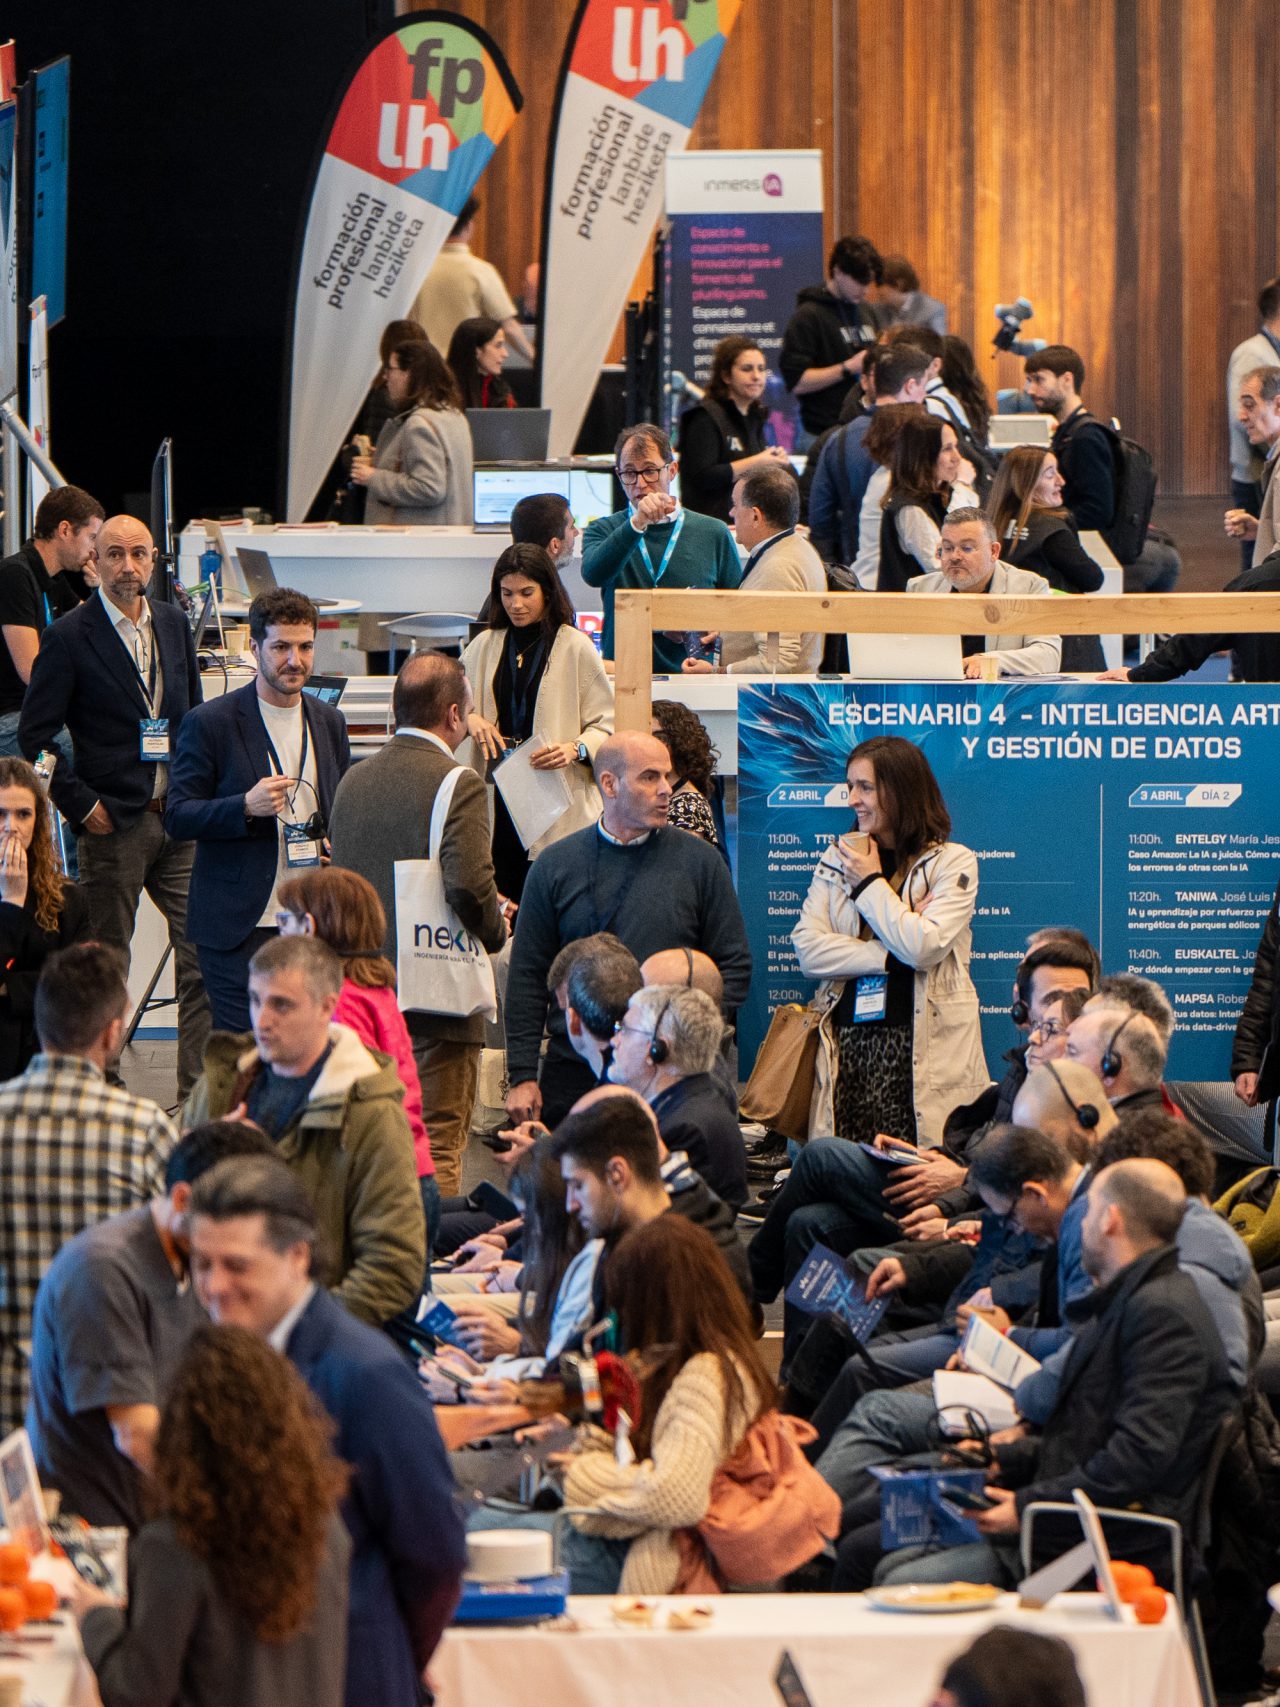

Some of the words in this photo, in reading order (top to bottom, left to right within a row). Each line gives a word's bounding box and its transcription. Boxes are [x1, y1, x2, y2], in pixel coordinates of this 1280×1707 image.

[612, 6, 686, 82] lh
[407, 38, 486, 118] fp
[377, 102, 450, 172] lh
[560, 103, 617, 217] formación
[609, 122, 655, 207] lanbide
[577, 110, 634, 240] profesional
[623, 131, 673, 226] heziketa
[313, 191, 371, 290] formación
[360, 209, 408, 282] lanbide
[326, 197, 388, 310] profesional
[373, 217, 425, 300] heziketa
[828, 703, 981, 726] ESCENARIO
[988, 703, 1006, 726] 4
[1041, 703, 1224, 726] INTELIGENCIA
[961, 736, 979, 759] Y
[987, 731, 1102, 759] GESTIÓN
[1111, 736, 1147, 759] DE
[1154, 736, 1242, 759] DATOS
[778, 790, 786, 800] 2
[788, 790, 822, 800] ABRIL
[1140, 790, 1148, 801] 3
[1150, 790, 1183, 801] ABRIL
[1202, 787, 1222, 801] DÍA
[1223, 790, 1230, 801] 2
[768, 834, 802, 844] 11:00h.
[1128, 834, 1163, 844] 11:00h.
[1175, 834, 1227, 844] ENTELGY
[1229, 834, 1259, 844] María
[767, 850, 809, 860] Adopción
[972, 850, 1016, 860] bajadores
[1128, 850, 1150, 859] Caso
[1151, 850, 1188, 859] Amazon:
[1188, 850, 1200, 859] La
[1201, 850, 1210, 859] IA
[1218, 850, 1244, 860] juicio.
[1245, 850, 1270, 859] Cómo
[767, 863, 779, 871] de
[781, 863, 817, 871] conocim
[1128, 863, 1142, 872] los
[1175, 863, 1187, 872] de
[1188, 864, 1211, 872] otras
[1229, 863, 1238, 872] la
[1239, 863, 1249, 872] IA
[768, 891, 801, 901] 11:20h.
[1128, 891, 1162, 902] 11:20h.
[1175, 891, 1218, 902] TANIWA
[1220, 891, 1247, 902] José
[1248, 892, 1270, 902] Luis
[767, 907, 801, 915] Gobiern
[978, 907, 990, 915] de
[991, 907, 1000, 915] la
[1001, 907, 1011, 915] IA
[1128, 908, 1137, 916] IA
[1138, 909, 1146, 918] y
[1147, 908, 1199, 918] aprendizaje
[1200, 909, 1215, 918] por
[1217, 908, 1254, 916] refuerzo
[1256, 909, 1271, 918] par
[1128, 921, 1176, 931] energética
[1177, 921, 1189, 929] de
[1190, 922, 1227, 931] parques
[1228, 921, 1260, 929] eólicos
[768, 935, 793, 945] 11:40
[767, 951, 777, 959] El
[988, 951, 1025, 960] aplicada
[1128, 949, 1162, 959] 11:40h.
[1175, 949, 1240, 959] EUSKALTEL
[780, 964, 789, 972] la
[1128, 965, 1143, 973] Por
[1145, 965, 1173, 973] dónde
[1175, 966, 1212, 975] empezar
[1232, 965, 1242, 973] la
[768, 990, 804, 1000] 12:00h.
[1174, 994, 1215, 1004] MAPSA
[1217, 994, 1248, 1004] Rober
[980, 1005, 1013, 1014] federad
[1173, 1010, 1188, 1018] tus
[1189, 1010, 1217, 1018] datos:
[1218, 1010, 1244, 1018] Inteli
[1192, 1023, 1238, 1031] data-drive
